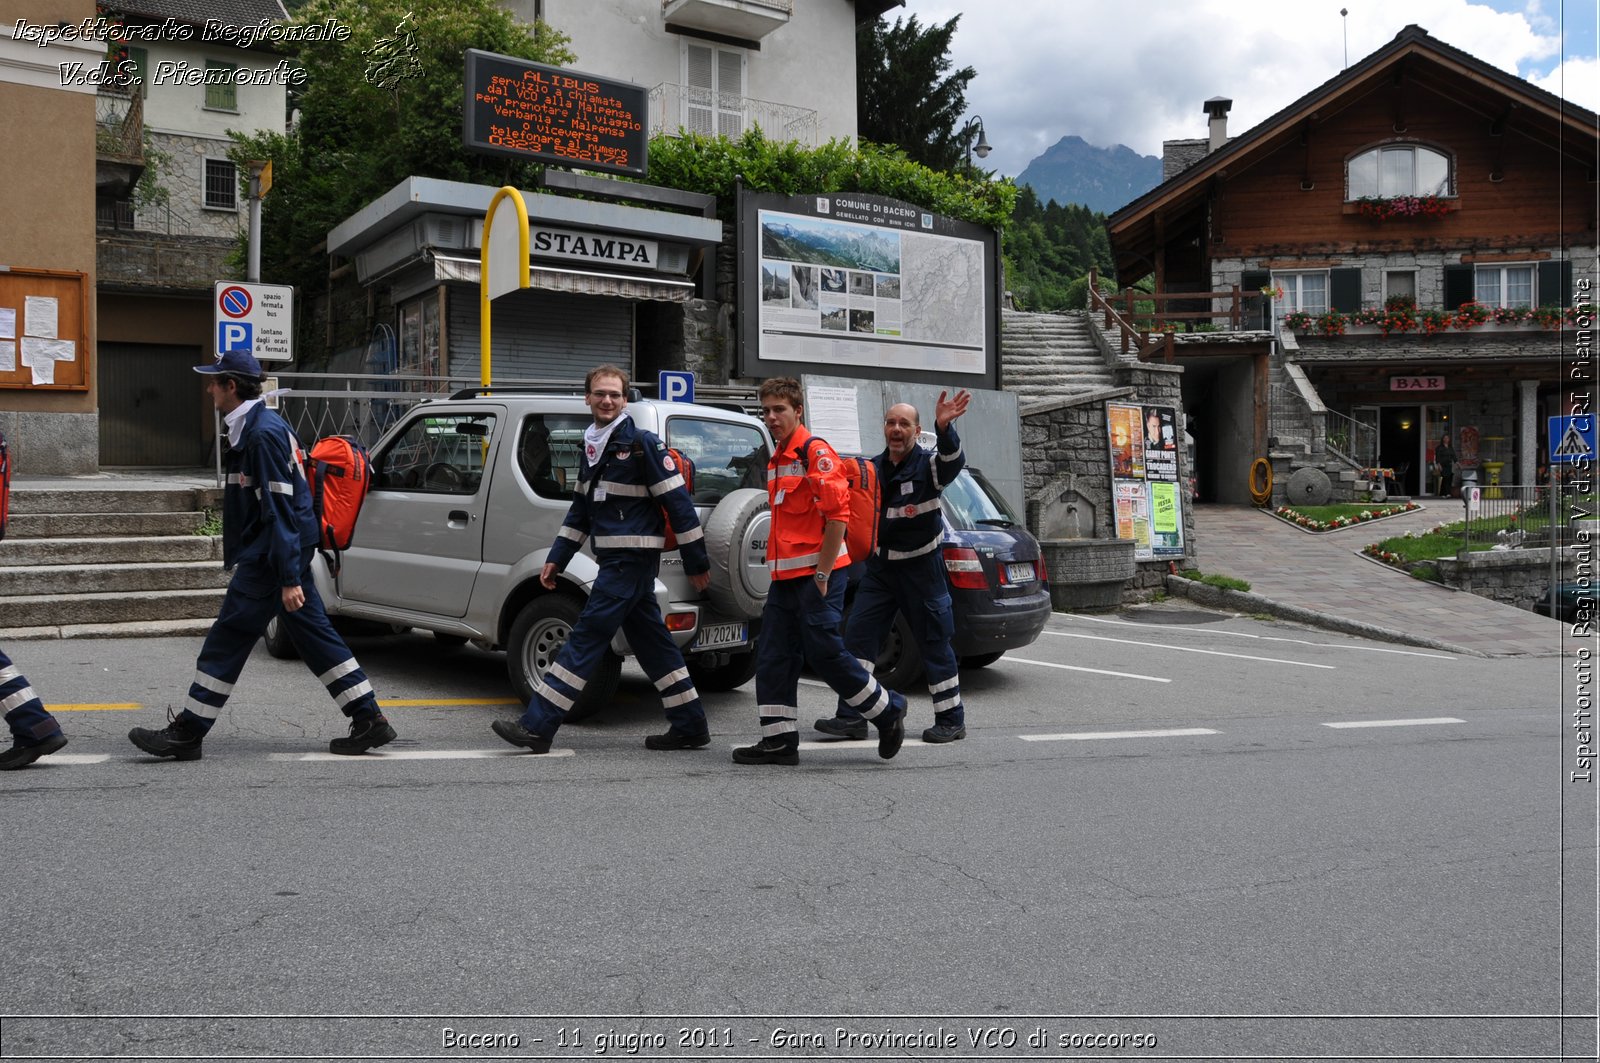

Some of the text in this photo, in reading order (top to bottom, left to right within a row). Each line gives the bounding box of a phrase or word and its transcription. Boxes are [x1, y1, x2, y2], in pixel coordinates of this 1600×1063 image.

[492, 76, 548, 94] servizio
[568, 90, 622, 108] chiamata
[524, 70, 599, 94] ALIBUS
[476, 94, 641, 131] per prenotare il viaggio
[488, 84, 632, 120] dal VCO alla Malpensa
[494, 104, 551, 124] Verbania
[572, 119, 624, 137] Malpensa
[537, 124, 599, 142] viceversa
[488, 135, 628, 167] 0323 552172
[490, 125, 628, 157] telefonare al numero
[835, 198, 916, 218] COMUNE DI BACENO
[836, 211, 869, 222] GEMELLATO
[873, 216, 885, 224] CON
[534, 231, 650, 263] STAMPA
[225, 325, 246, 351] P
[667, 376, 687, 400] P
[1396, 378, 1439, 389] BAR
[699, 622, 742, 645] DV 202WX
